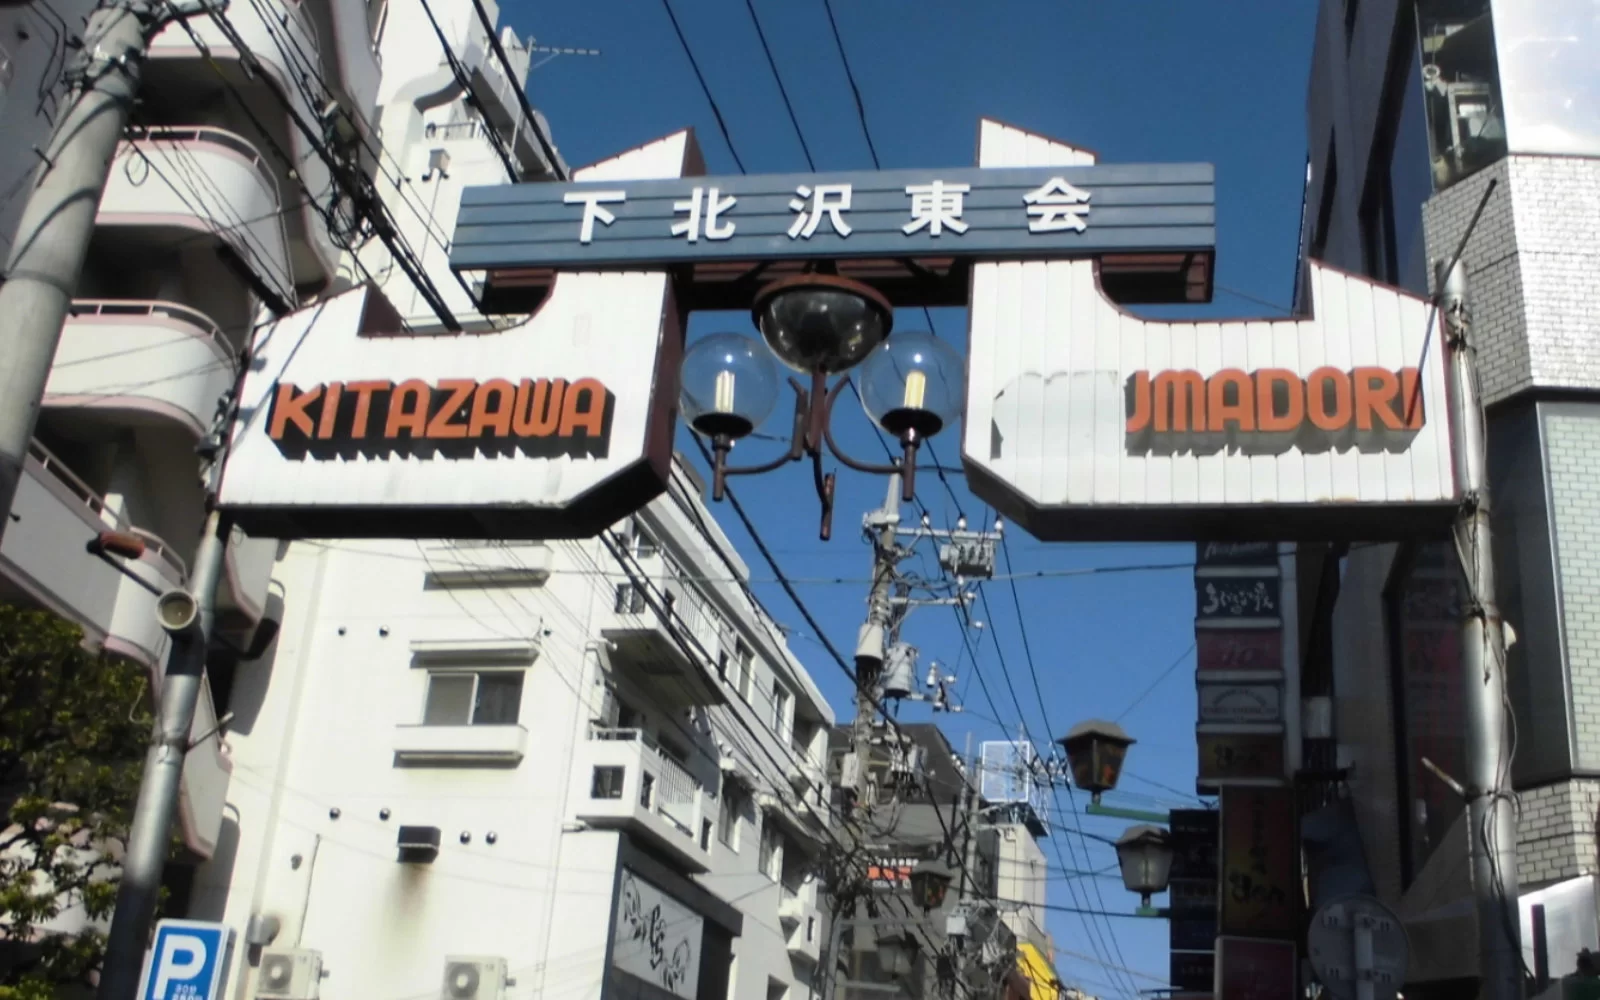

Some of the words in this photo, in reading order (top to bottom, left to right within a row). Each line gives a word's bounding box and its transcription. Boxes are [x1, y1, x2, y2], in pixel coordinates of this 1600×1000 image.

[563, 176, 1092, 243] 下北沢東会
[269, 378, 607, 440] KITAZAWA
[153, 934, 207, 1000] P
